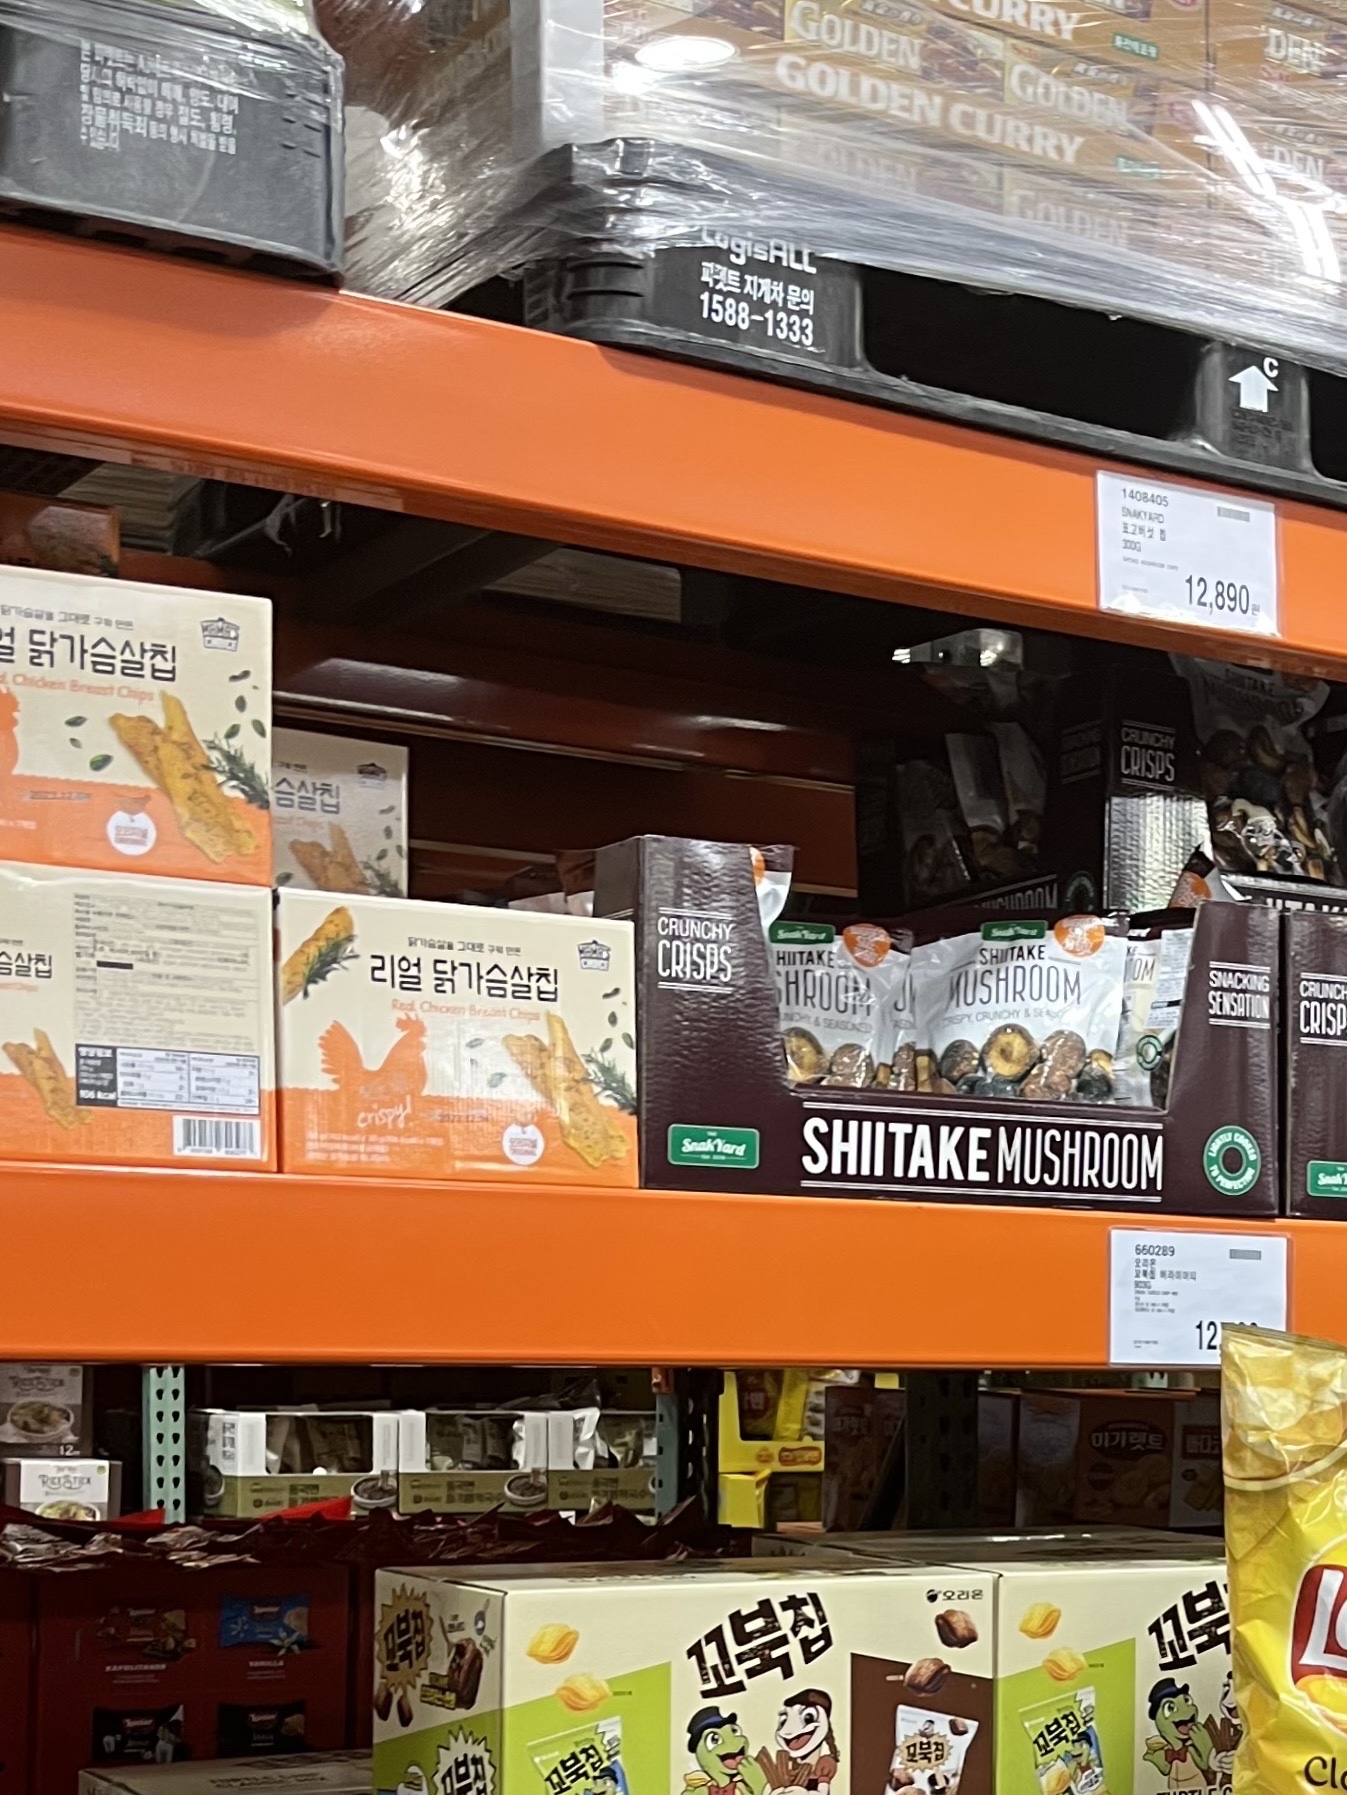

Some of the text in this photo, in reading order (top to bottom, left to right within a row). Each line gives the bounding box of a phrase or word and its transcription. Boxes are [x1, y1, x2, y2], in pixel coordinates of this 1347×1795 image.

[791, 4, 924, 75] GOLDEN
[777, 54, 1085, 164] GOLDEN CURRY
[744, 275, 785, 307] 지게차
[787, 284, 814, 315] 문의
[700, 292, 814, 346] 1588-1333
[1122, 488, 1169, 507] 1408405
[1185, 574, 1250, 615] 12,890
[29, 629, 176, 683] 닭가슴살칩
[1120, 727, 1176, 749] CRUNCHY
[1120, 745, 1176, 783] CRISPS
[657, 916, 735, 942] CRUNCHY
[370, 955, 559, 1003] 리얼 닭가슴살칩
[657, 939, 733, 983] CRISPS
[951, 964, 1081, 1009] MUSHROOM
[1208, 970, 1271, 993] SNACKING
[421, 1001, 467, 1017] Chicken
[509, 1008, 541, 1023] Chips
[1208, 990, 1271, 1020] SENSATION
[802, 1117, 1163, 1191] SHIITAKE MUSHROOM
[1134, 1244, 1176, 1257] 660289
[1091, 1430, 1164, 1452] 마가렛트
[942, 1588, 983, 1602] 오리온
[687, 1592, 833, 1699] 꼬북칩
[545, 1742, 604, 1795] 꼬북칩
[905, 1739, 945, 1766] 꼬북칩
